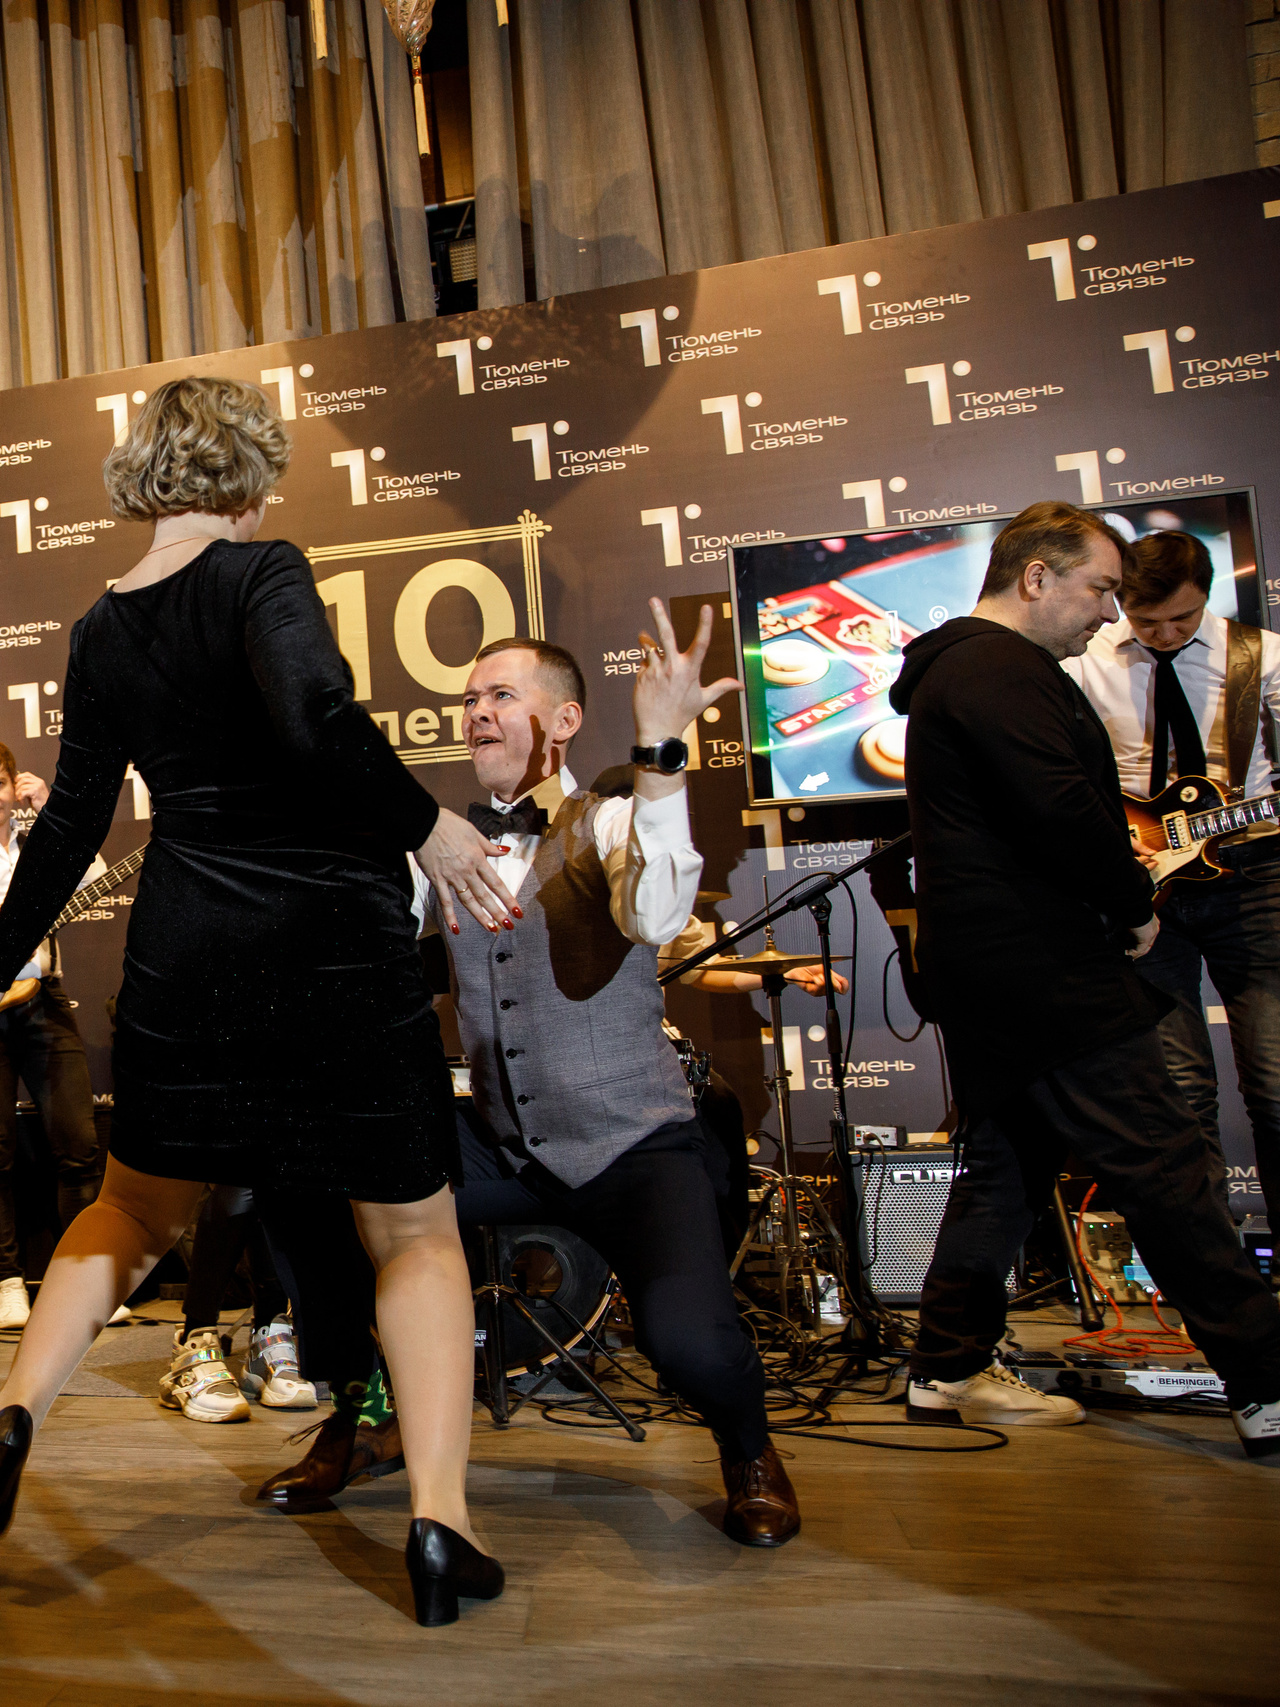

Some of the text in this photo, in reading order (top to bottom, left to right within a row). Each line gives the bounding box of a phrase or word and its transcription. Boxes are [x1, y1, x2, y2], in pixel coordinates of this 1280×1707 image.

[1081, 256, 1195, 282] Тюмень
[1083, 274, 1166, 297] связь
[866, 290, 970, 316] Тюмень
[868, 309, 945, 330] связь
[665, 326, 762, 350] Тюмень
[667, 343, 739, 363] связь
[1179, 350, 1280, 374] Тюмен
[479, 356, 570, 380] Тюмень
[1182, 368, 1269, 389] связь
[481, 373, 547, 392] связь
[300, 383, 387, 405] Тюмень
[955, 382, 1064, 407] Тюмень
[302, 400, 365, 418] связь
[958, 402, 1037, 421] связь
[748, 415, 848, 438] Тюмень
[750, 432, 823, 451] связь
[556, 442, 649, 464] Тюмень
[558, 460, 627, 477] связь
[372, 469, 461, 490] Тюмень
[1109, 473, 1225, 496] Тюмень
[373, 486, 439, 503] связь
[892, 502, 998, 524] Тюмень
[36, 519, 115, 539] Тюмень
[37, 533, 95, 551] связь
[780, 693, 857, 733] START
[1159, 1377, 1216, 1387] BEHRINGER
